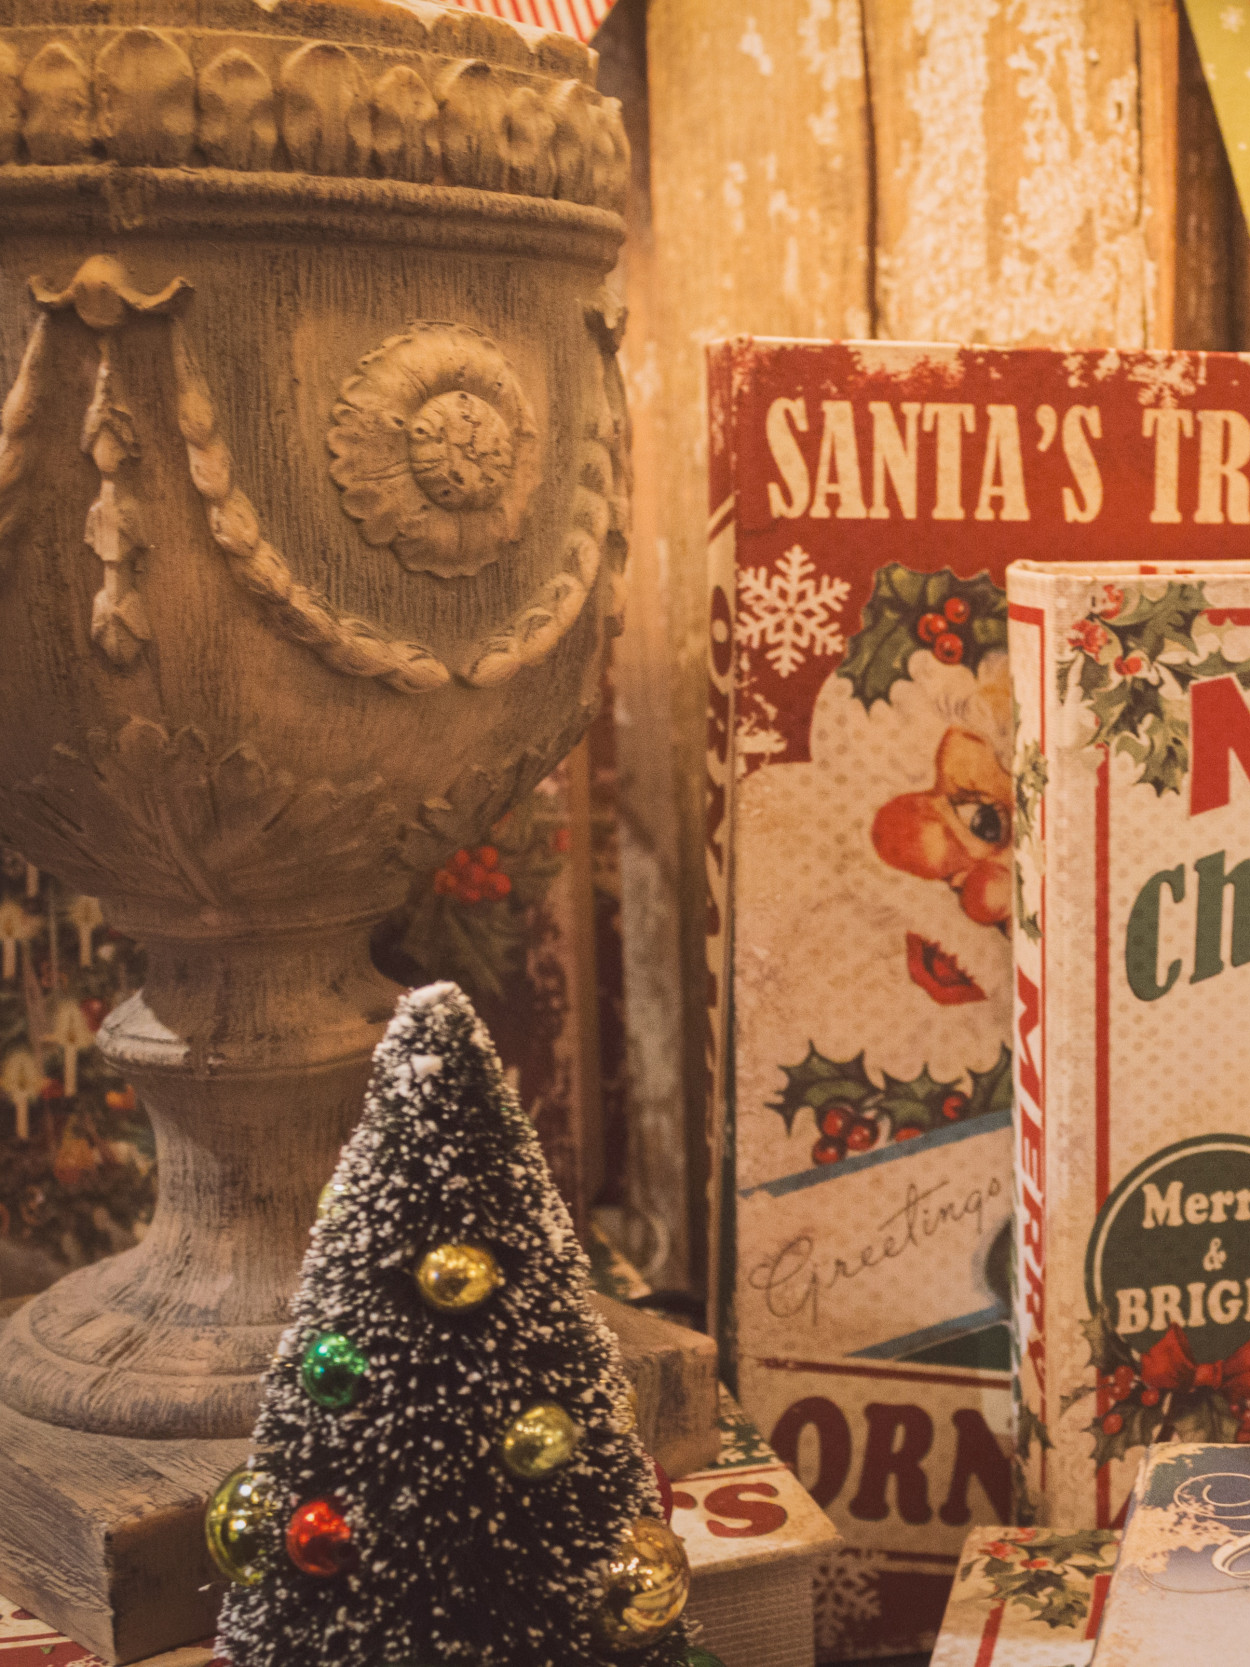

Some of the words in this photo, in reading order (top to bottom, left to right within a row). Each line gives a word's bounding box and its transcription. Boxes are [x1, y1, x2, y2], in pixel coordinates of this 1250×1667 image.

[766, 395, 1103, 523] SANTA'S
[748, 1179, 1001, 1326] Greetings
[1202, 1238, 1227, 1271] &
